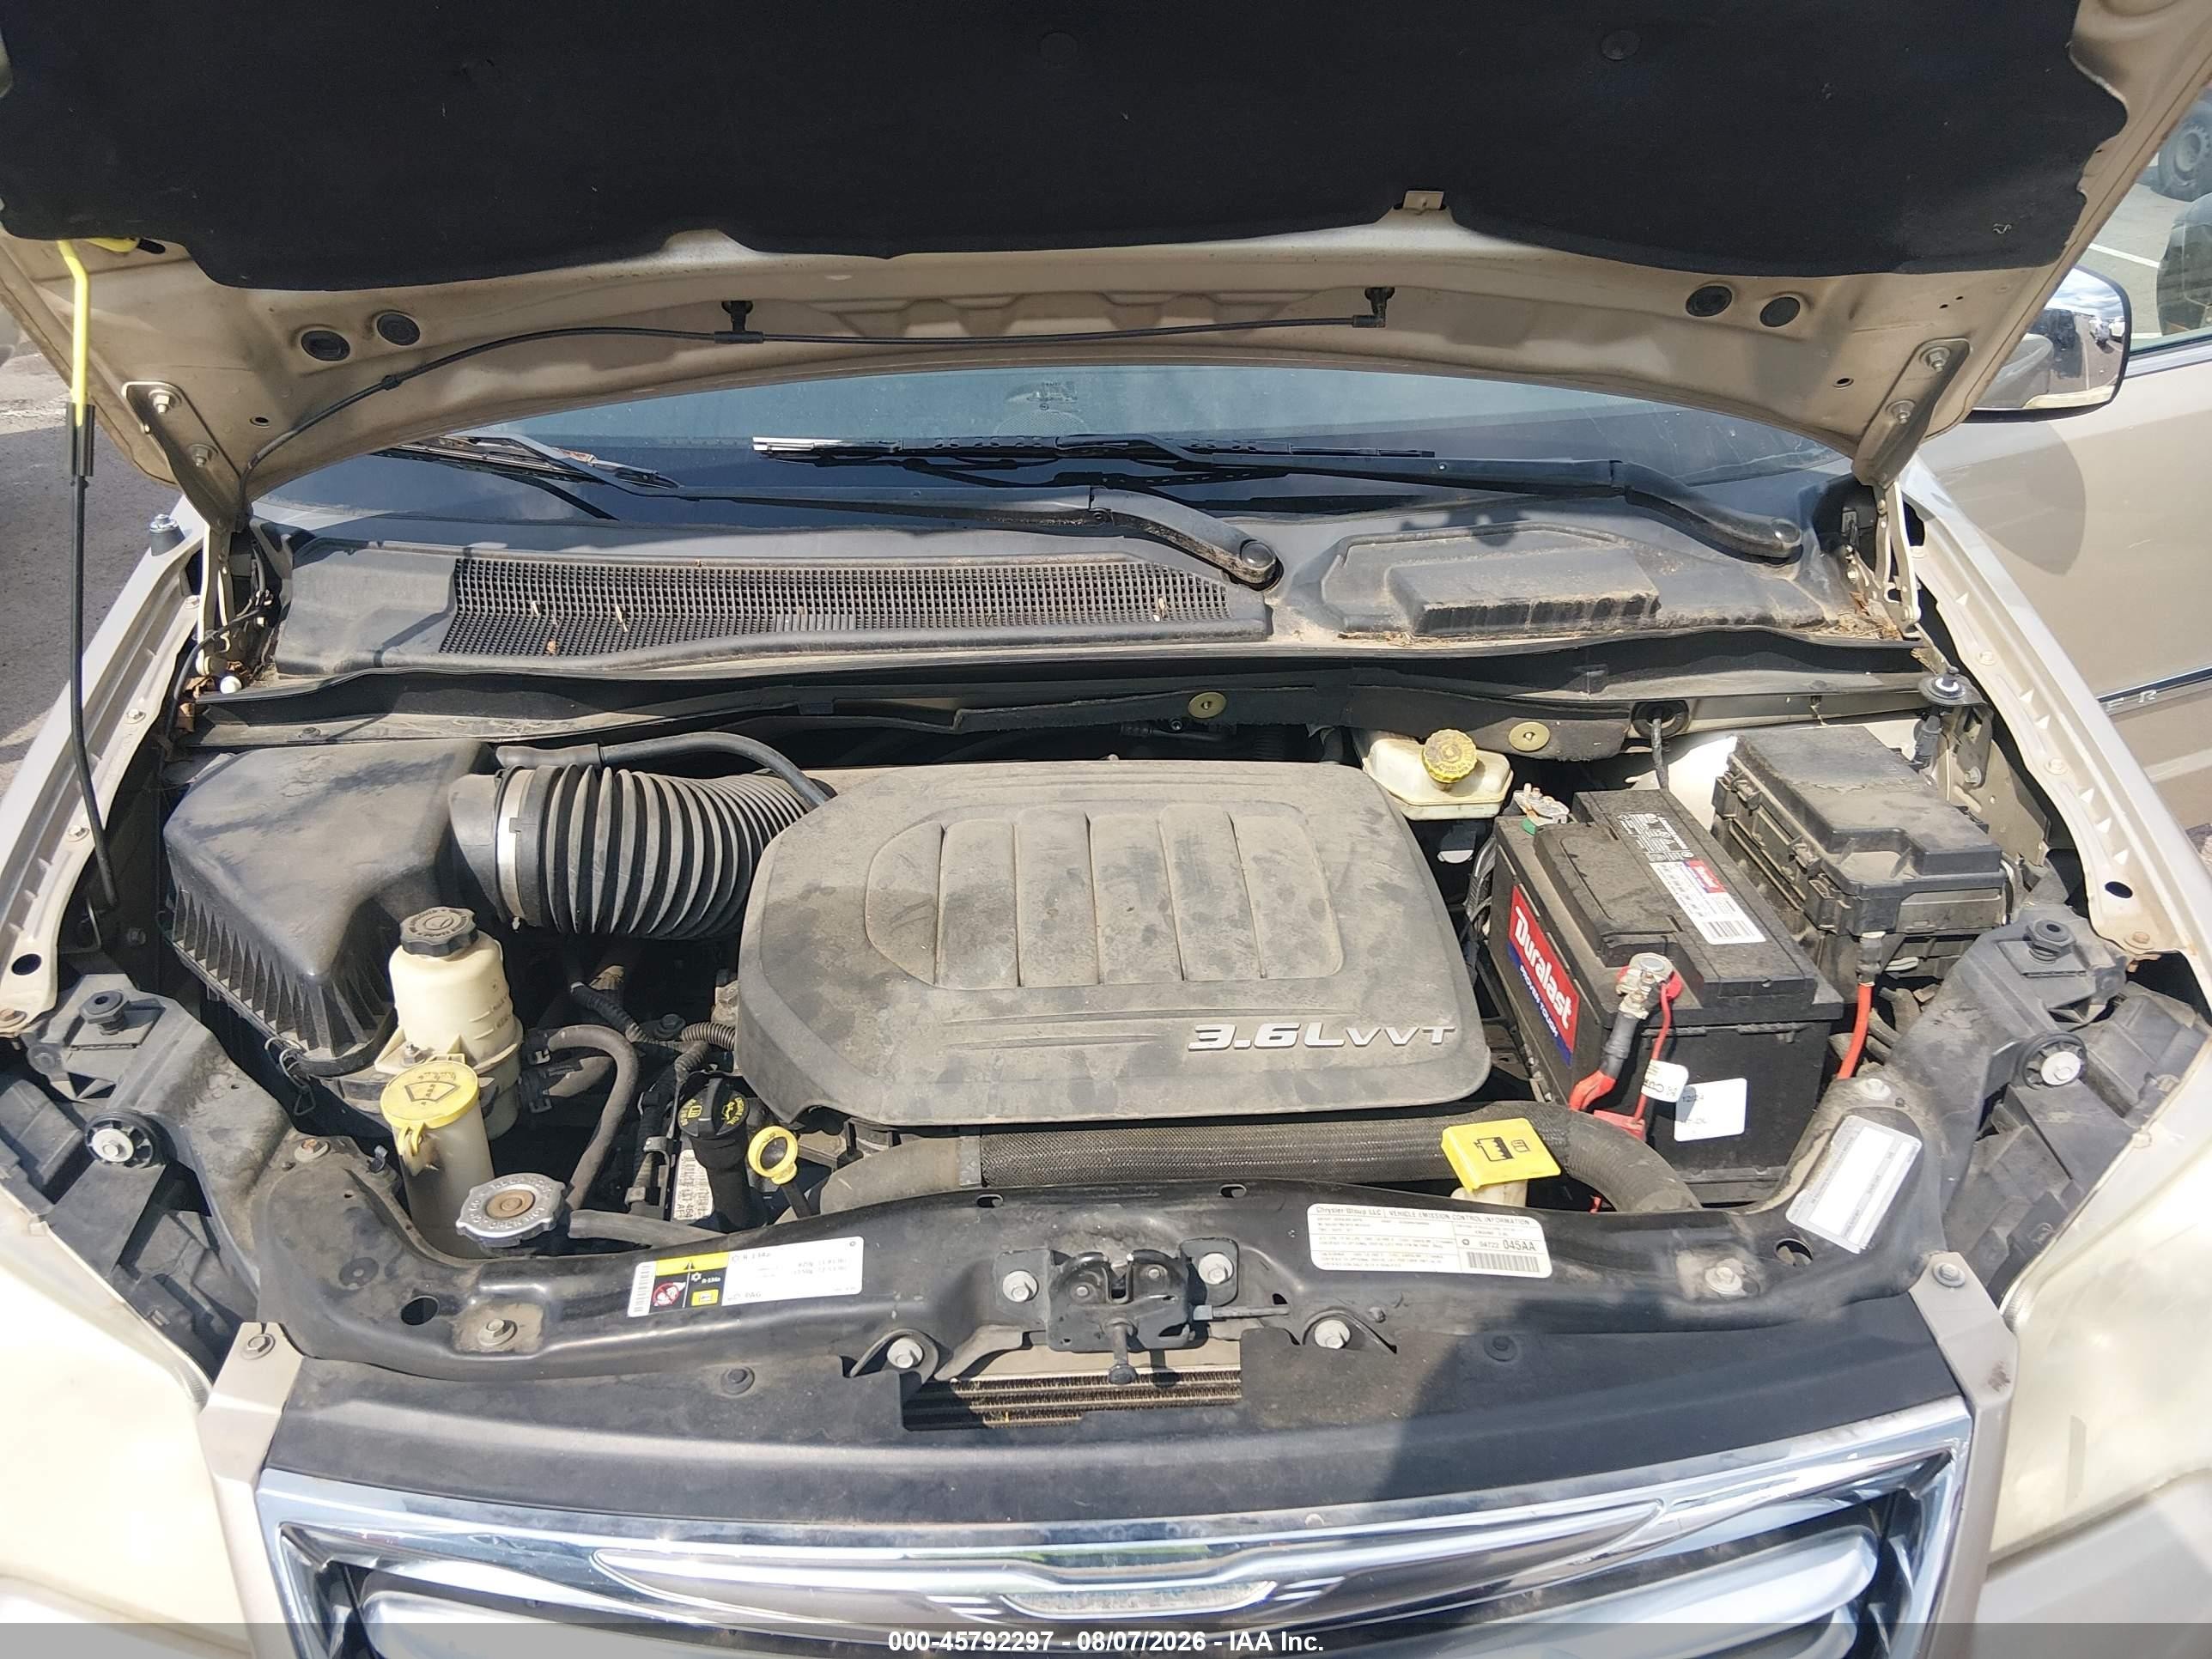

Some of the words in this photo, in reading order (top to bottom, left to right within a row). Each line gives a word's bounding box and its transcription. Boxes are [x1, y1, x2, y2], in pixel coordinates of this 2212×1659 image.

[1515, 906, 1572, 1030] Duralast
[1520, 964, 1540, 1004] PROVEN
[1540, 1002, 1559, 1038] TOUGH
[1188, 1021, 1346, 1052] 3.6L
[1346, 1026, 1456, 1047] VVT
[1369, 1207, 1382, 1216] LLC
[1389, 1209, 1416, 1218] VEHICLE
[1418, 1211, 1450, 1220] EMISSION
[1452, 1213, 1482, 1223] CONTROL
[1484, 1215, 1530, 1225] INFORMATION
[1503, 1239, 1536, 1251] 045AA
